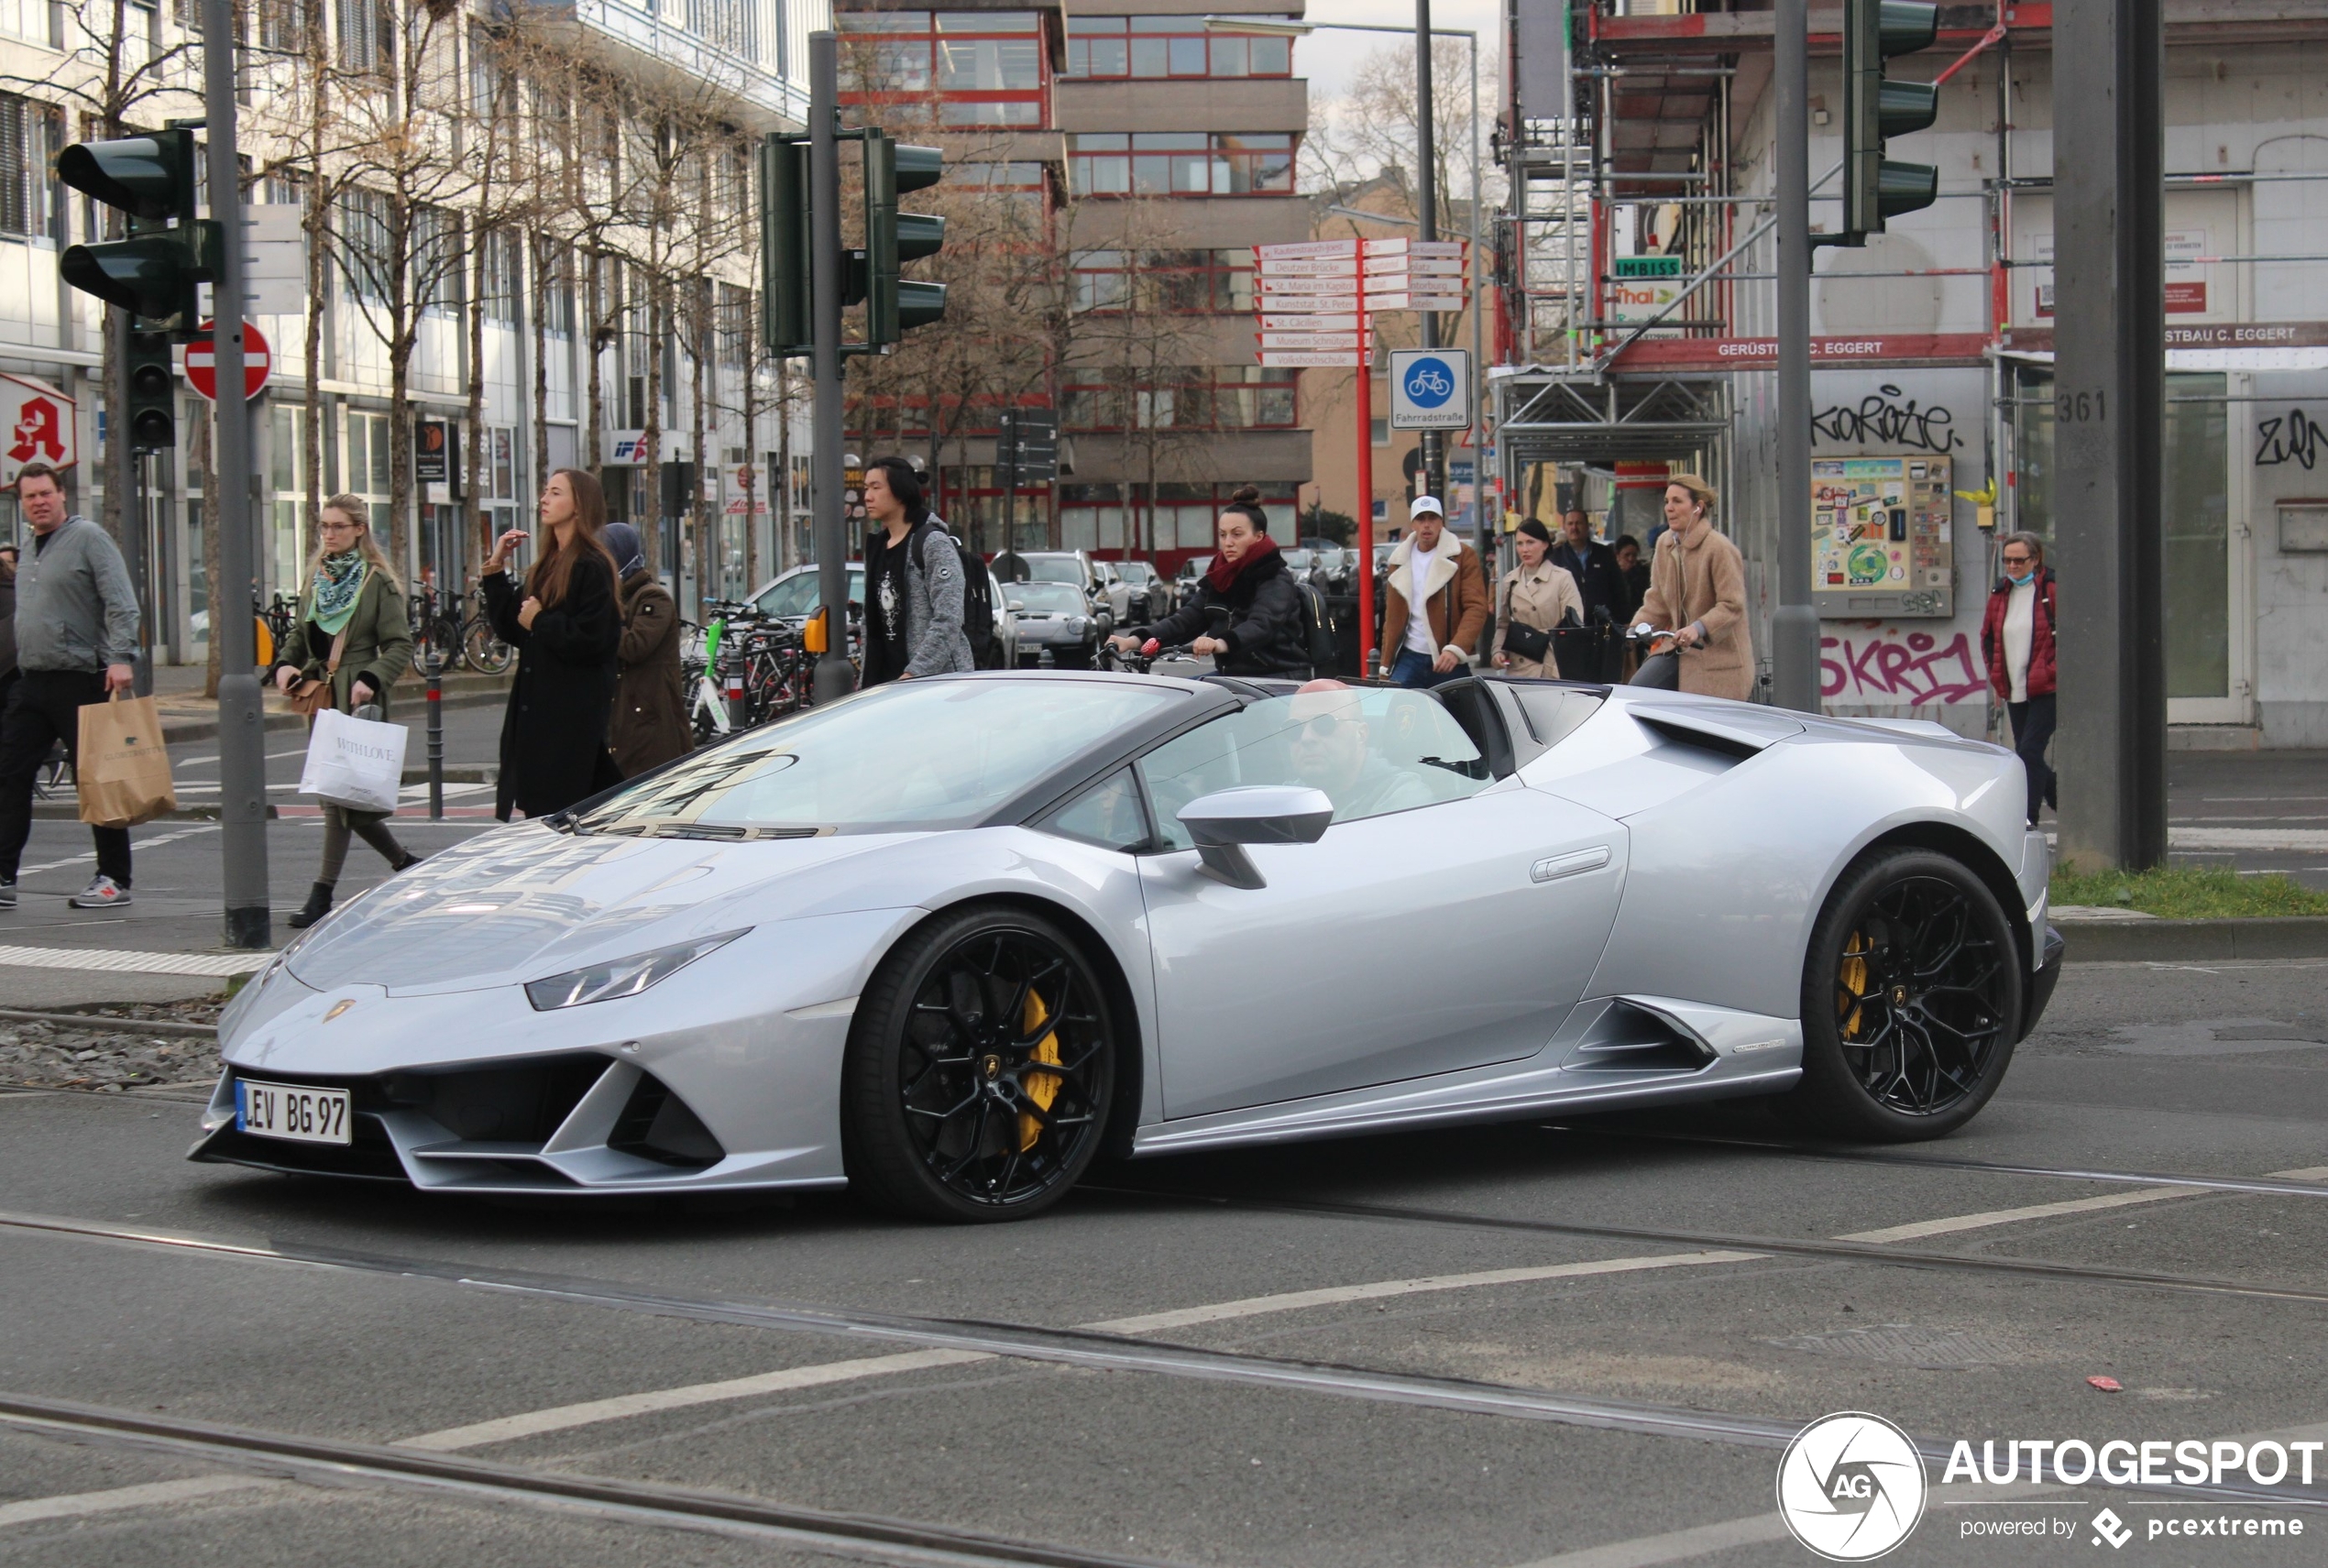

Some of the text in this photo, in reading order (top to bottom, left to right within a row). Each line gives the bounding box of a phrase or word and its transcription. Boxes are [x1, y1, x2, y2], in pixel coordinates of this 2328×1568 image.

[1275, 262, 1340, 272] Deutzer Brücke
[1411, 263, 1431, 273] platz
[1616, 262, 1677, 276] IMBISS
[1276, 281, 1355, 292] St. Maria im Kapitol
[1411, 280, 1448, 291] ntorburg
[1320, 299, 1329, 309] St.
[1332, 299, 1354, 309] Peter
[1277, 317, 1323, 327] St. Cäcilien
[2164, 327, 2295, 343] STBAU C. EGGERT
[1277, 335, 1355, 347] Museum Schnütgen
[1719, 342, 1883, 356] GERÜST C. EGGERT
[1277, 355, 1347, 365] Volkshochschule
[2059, 389, 2105, 422] 361
[1395, 412, 1464, 422] Fahrradstraße
[245, 1088, 346, 1135] LEV BG 97
